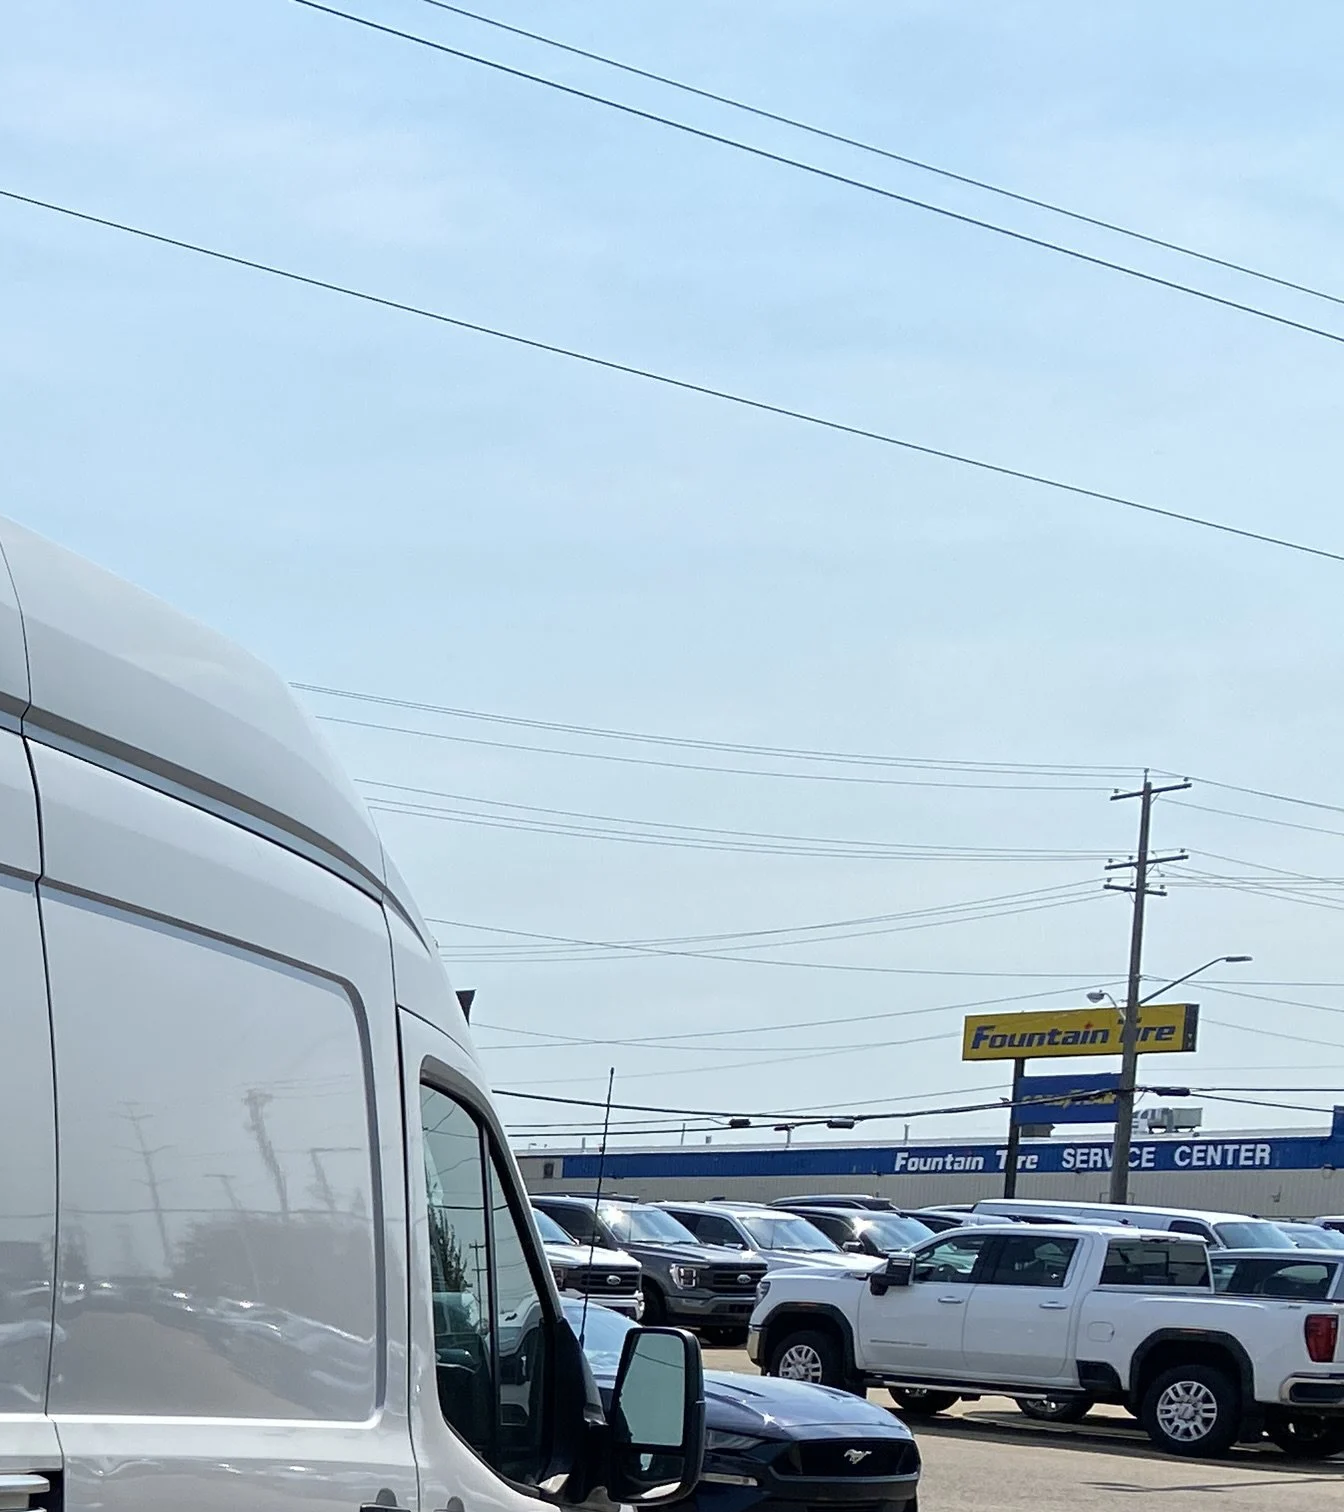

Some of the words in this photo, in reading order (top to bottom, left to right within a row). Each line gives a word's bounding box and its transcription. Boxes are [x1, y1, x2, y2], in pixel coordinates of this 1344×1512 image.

[972, 1022, 1110, 1049] Fountain
[895, 1152, 984, 1171] Fountain
[996, 1150, 1038, 1169] Tre
[1062, 1147, 1156, 1168] SERVCE
[1174, 1144, 1271, 1166] CENTER
